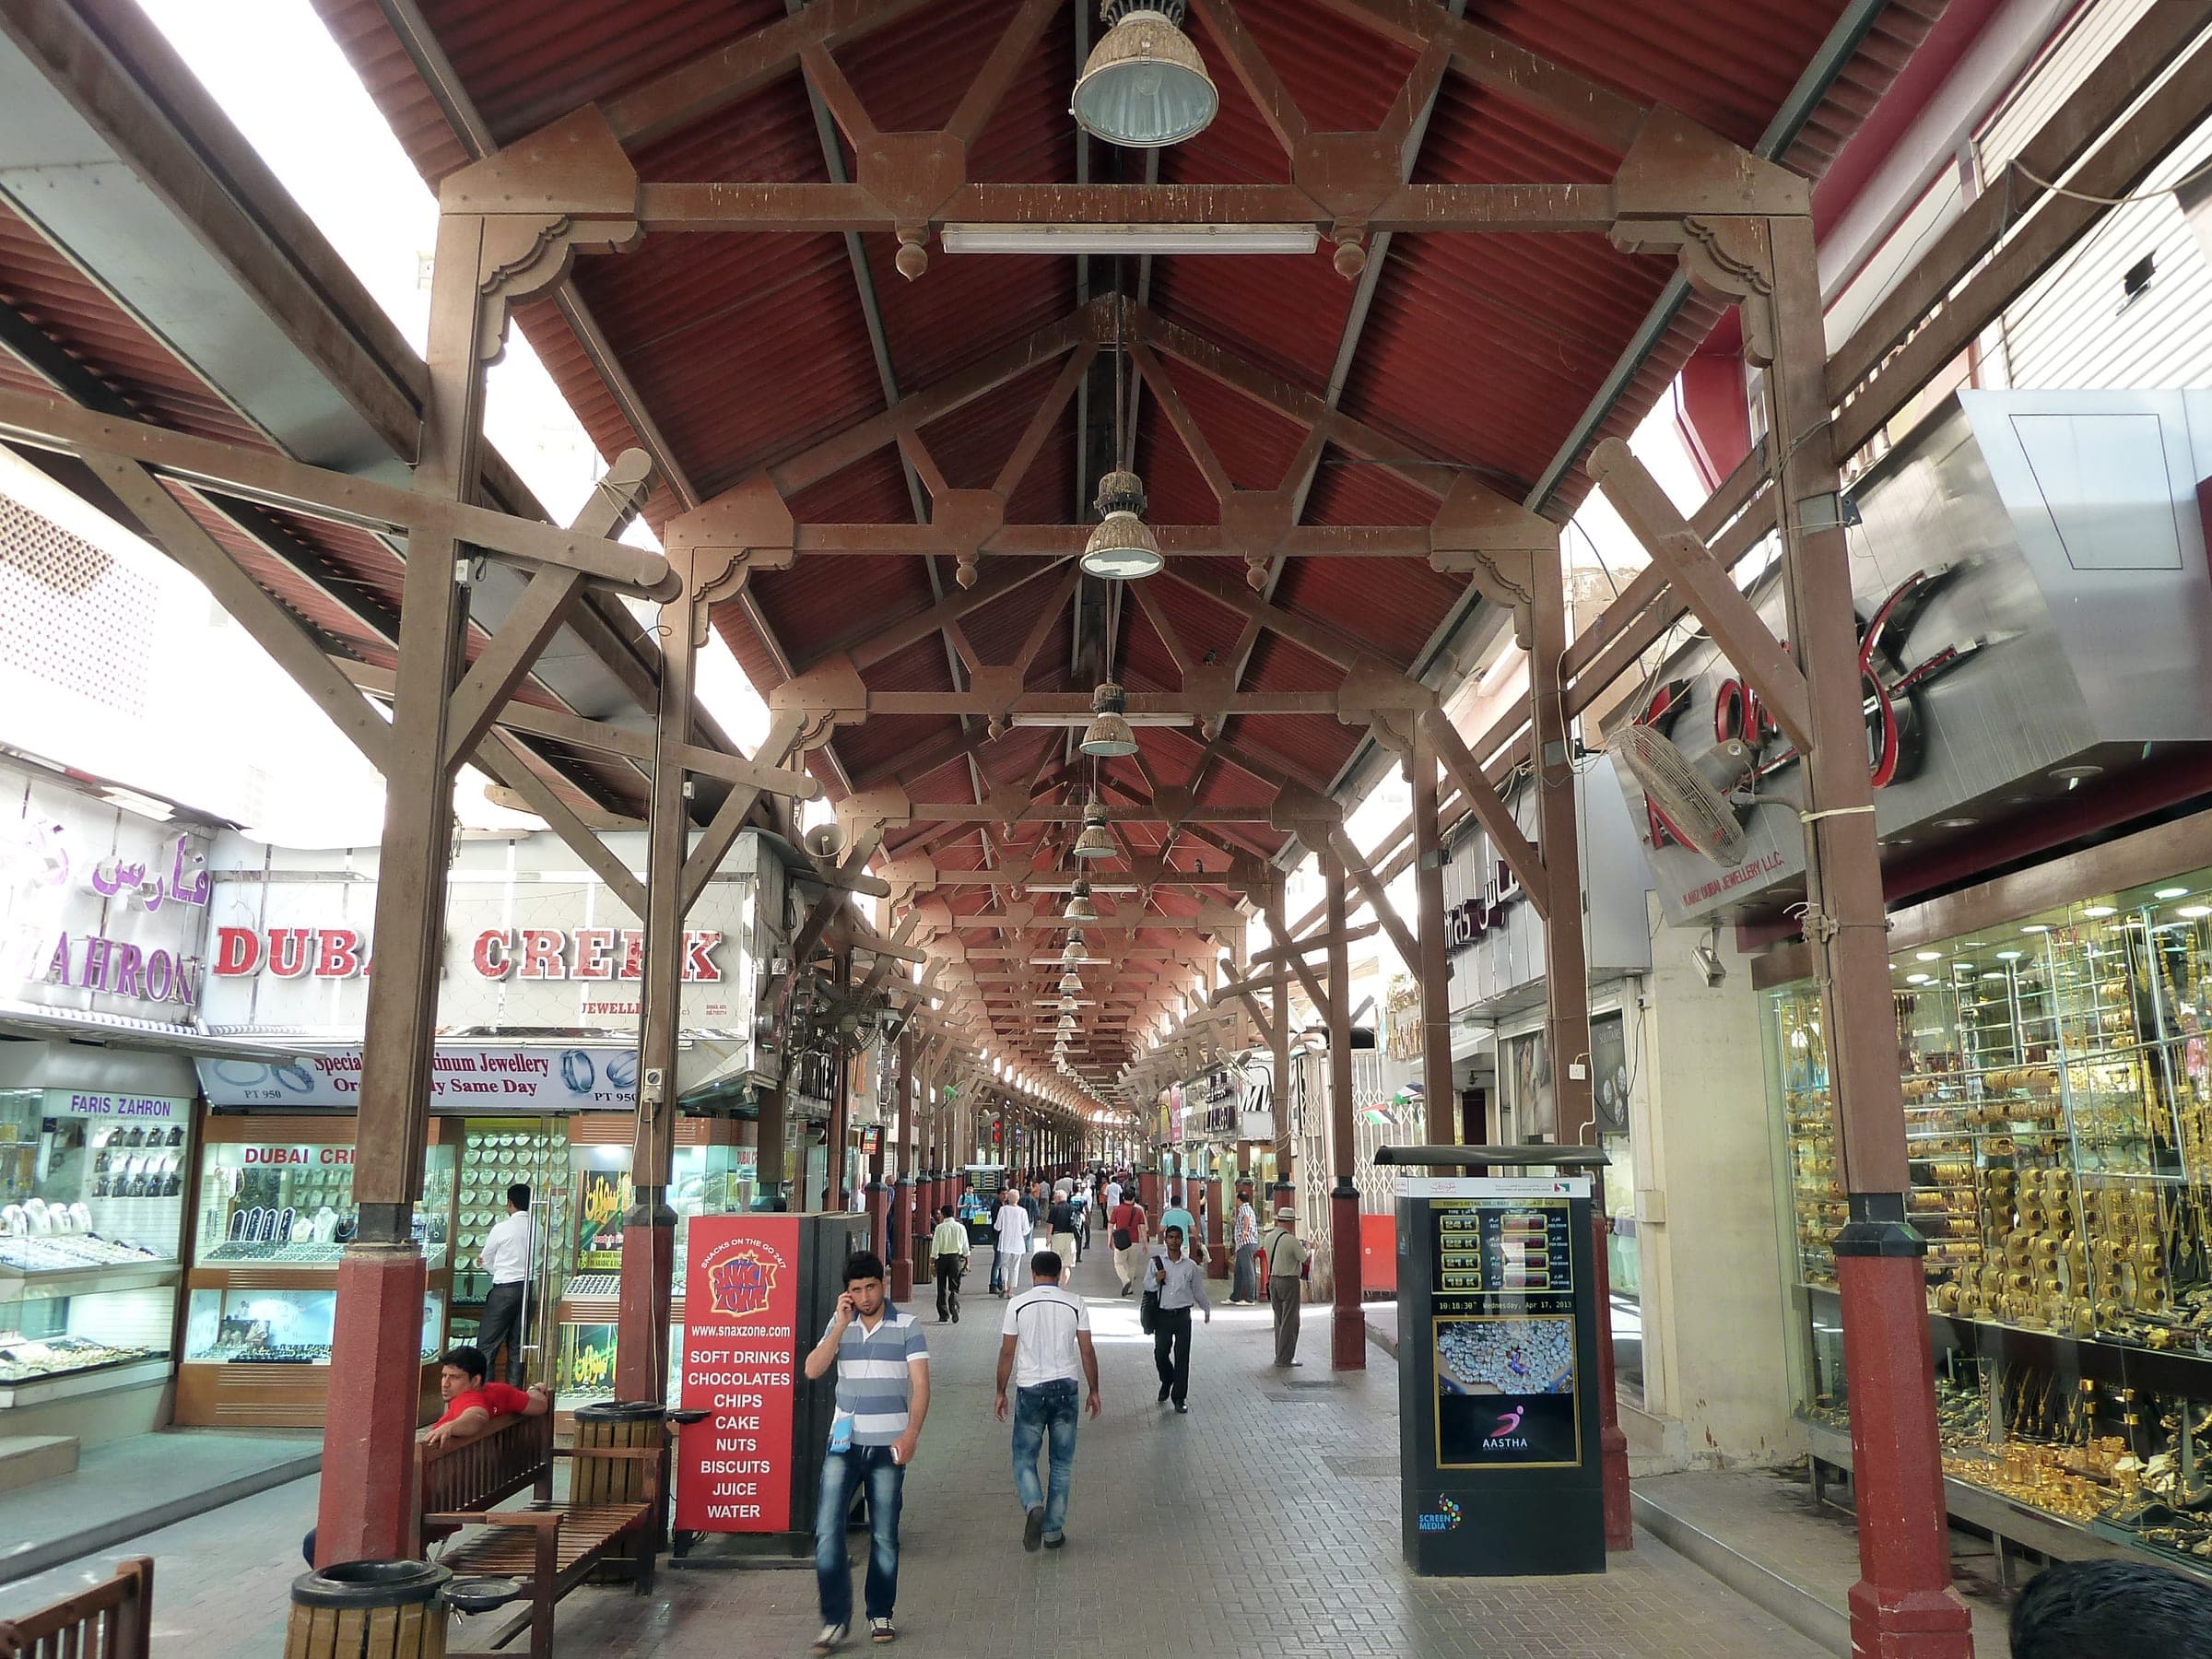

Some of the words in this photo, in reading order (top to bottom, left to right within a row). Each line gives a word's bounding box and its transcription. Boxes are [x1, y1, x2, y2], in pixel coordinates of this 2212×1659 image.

[1722, 859, 1761, 889] JEWELLERY
[213, 926, 371, 978] DUB
[479, 1053, 549, 1077] Jewellery
[244, 1089, 260, 1099] PT
[262, 1089, 282, 1099] 950
[450, 1078, 499, 1093] Same
[501, 1079, 537, 1097] Day
[594, 1092, 613, 1101] PT
[70, 1095, 112, 1113] FARIS
[117, 1098, 171, 1117] ZAHRON
[245, 1148, 309, 1164] DUBAI
[1444, 1221, 1462, 1230] 24
[1465, 1221, 1474, 1230] K
[1445, 1240, 1462, 1248] 22
[1465, 1240, 1474, 1248] K
[700, 1241, 730, 1269] SNACKS
[745, 1238, 761, 1247] THE
[762, 1243, 775, 1254] GO
[1446, 1259, 1463, 1267] 21
[1465, 1259, 1475, 1267] K
[1466, 1278, 1475, 1287] K
[691, 1325, 791, 1337] www.snaxzone.com
[690, 1350, 730, 1364] SOFT
[734, 1351, 790, 1364] DRINKS
[688, 1372, 790, 1386] CHOCOLATES
[713, 1394, 763, 1407] CHIPS
[715, 1416, 760, 1430] CAKE
[716, 1438, 757, 1452] NUTS
[1483, 1438, 1528, 1447] AASTHA
[700, 1460, 771, 1474] BISCUITS
[712, 1482, 758, 1496] JUICE
[707, 1504, 760, 1518] WATER
[1419, 1513, 1451, 1523] SCREEN
